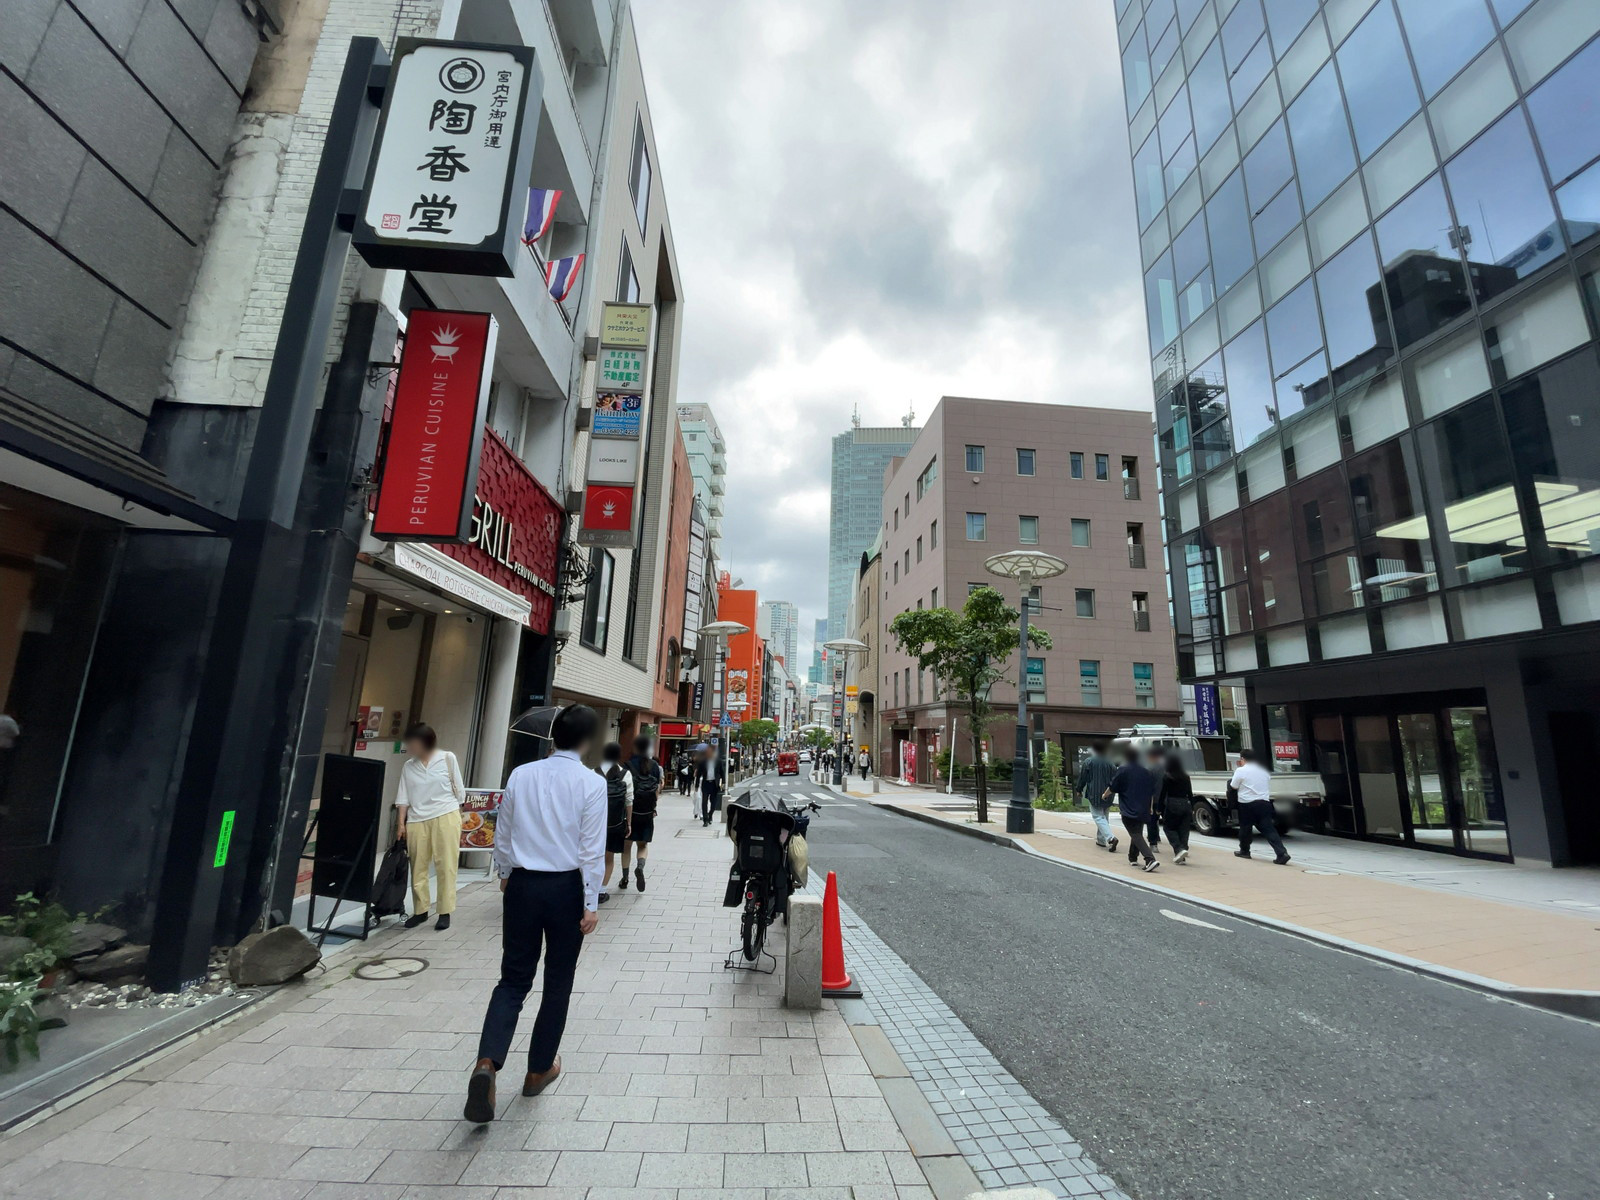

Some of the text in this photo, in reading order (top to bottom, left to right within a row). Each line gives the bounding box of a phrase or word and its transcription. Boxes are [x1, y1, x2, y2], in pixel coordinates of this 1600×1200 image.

[484, 70, 512, 149] 宮内庁御用達
[406, 99, 478, 234] 陶香堂
[626, 398, 640, 408] 3F
[410, 372, 449, 525] PERUVIAN CUISINE
[398, 552, 441, 586] CHARCOAL
[444, 575, 480, 602] ROTISSERIE
[481, 594, 506, 615] CHICKEN
[514, 562, 556, 598] PERUVIAN CUISINE
[1274, 745, 1299, 755] FOR RENT
[466, 795, 489, 803] LUNCH
